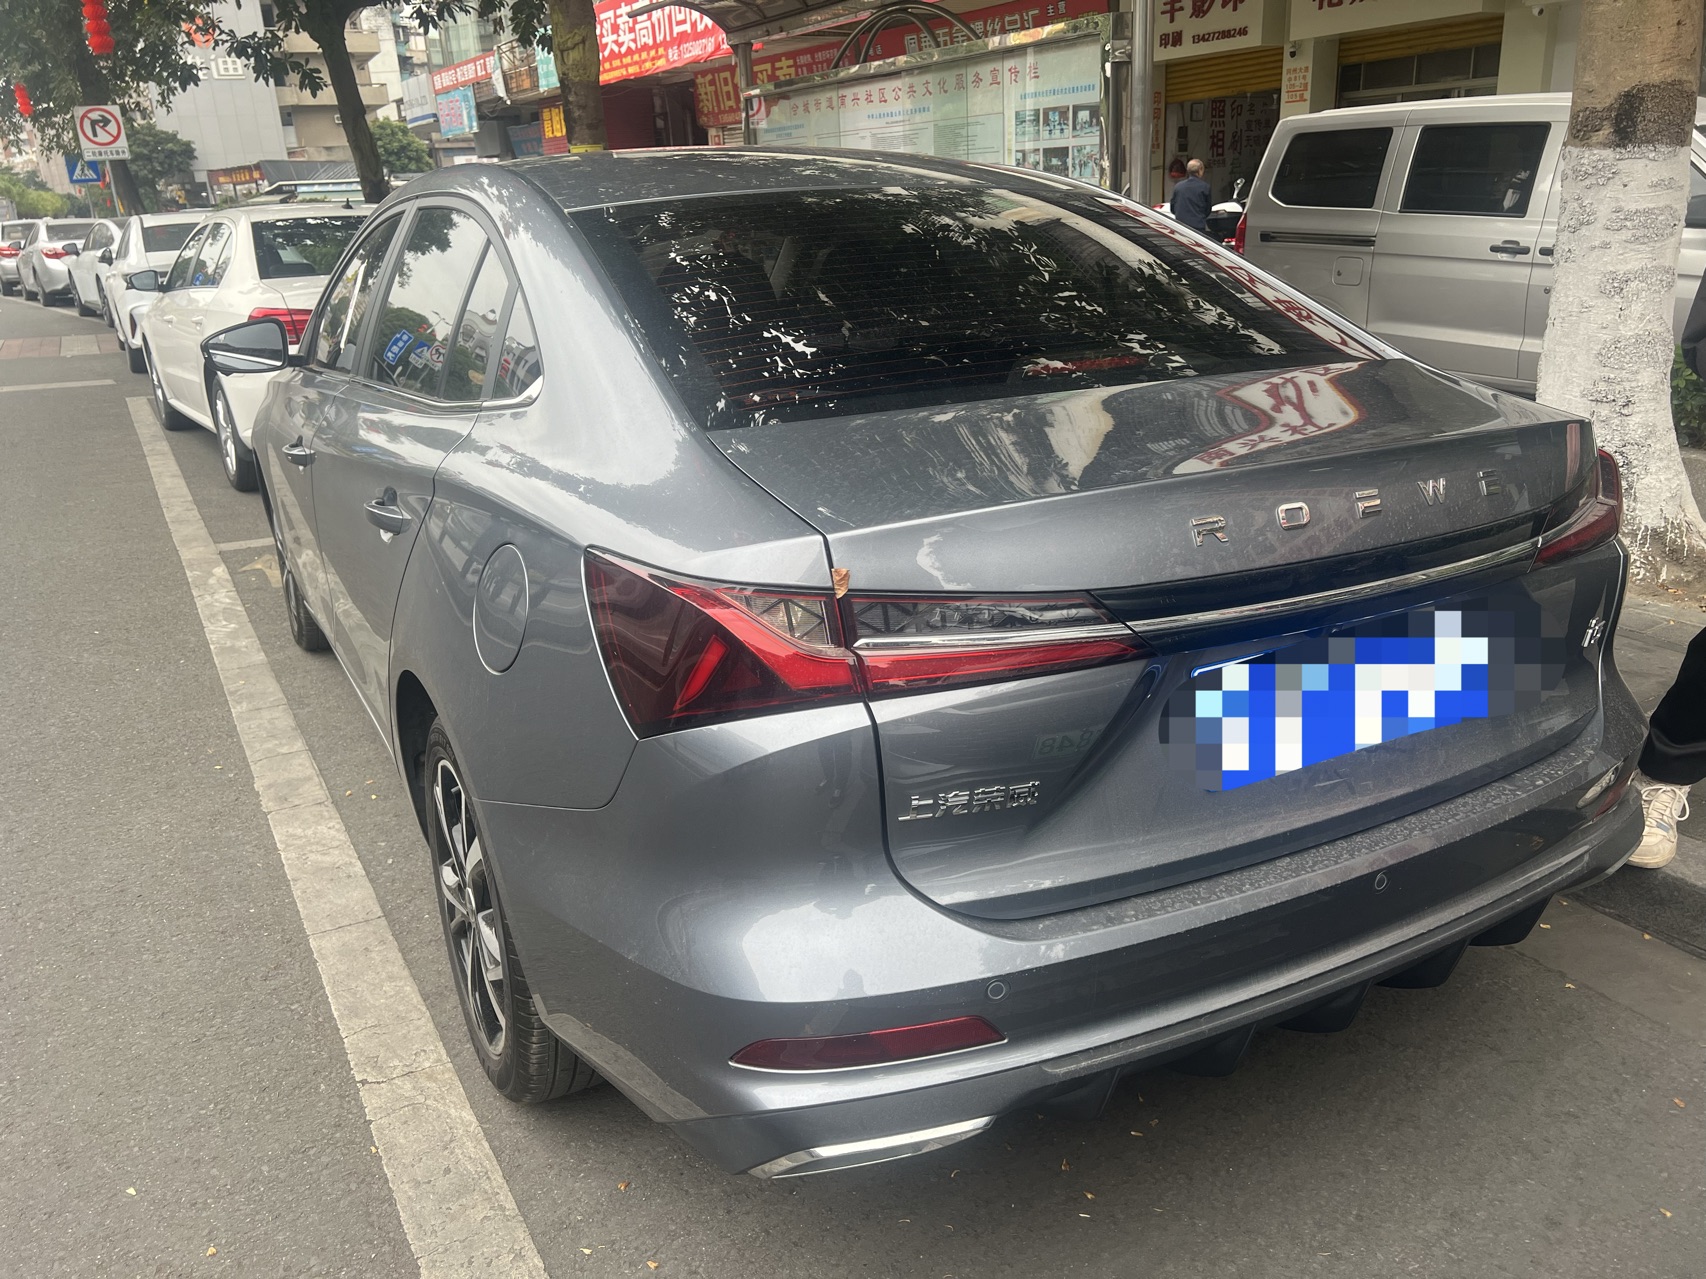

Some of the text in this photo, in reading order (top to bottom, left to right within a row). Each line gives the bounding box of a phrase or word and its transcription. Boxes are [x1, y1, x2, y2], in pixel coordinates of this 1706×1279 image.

[1159, 26, 1248, 49] 印刷 13427288246
[791, 61, 1041, 116] 台城街道南兴社区公共文化服务宣传栏
[1210, 99, 1226, 158] 照相
[1191, 469, 1502, 547] ROEWE
[897, 781, 1040, 822] 上汽荣威
